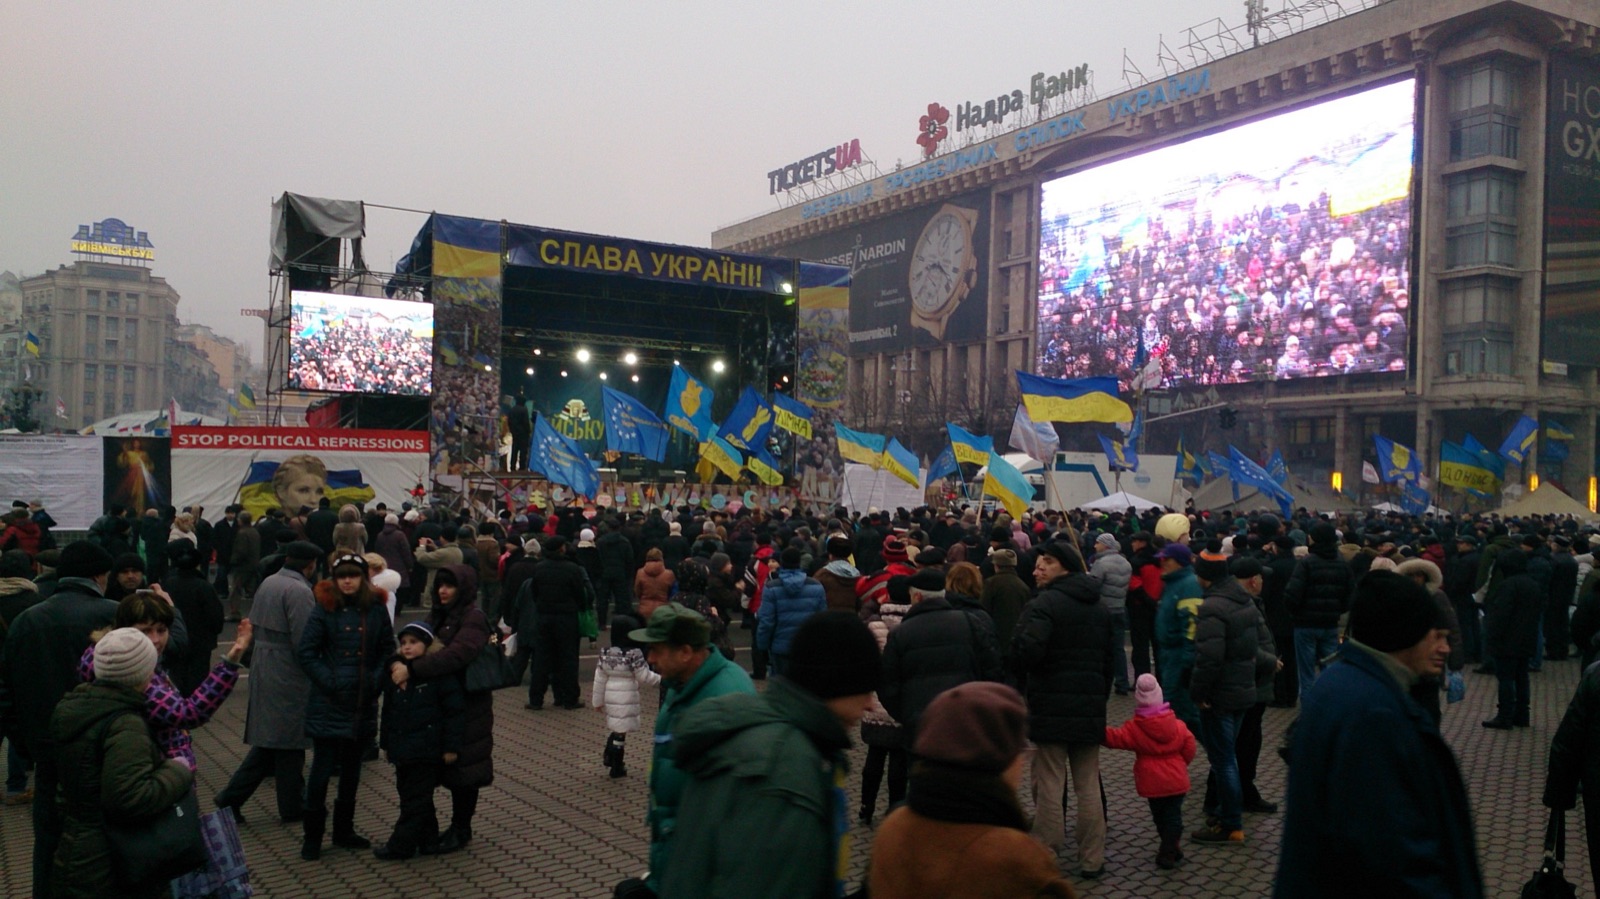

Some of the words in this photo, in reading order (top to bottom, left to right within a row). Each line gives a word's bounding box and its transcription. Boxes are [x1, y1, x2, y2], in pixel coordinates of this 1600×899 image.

[956, 101, 1024, 132] Надра
[1030, 63, 1089, 105] Банк
[1014, 111, 1087, 152] СПІЛОК
[1107, 67, 1210, 120] УКРАЇНИ
[540, 239, 643, 274] СЛАВА
[650, 252, 762, 288] УКРАЇНІ!
[859, 238, 906, 262] NARDIN
[178, 433, 224, 446] STOP
[228, 435, 315, 447] POLITICAL
[318, 437, 424, 450] REPRESSIONS
